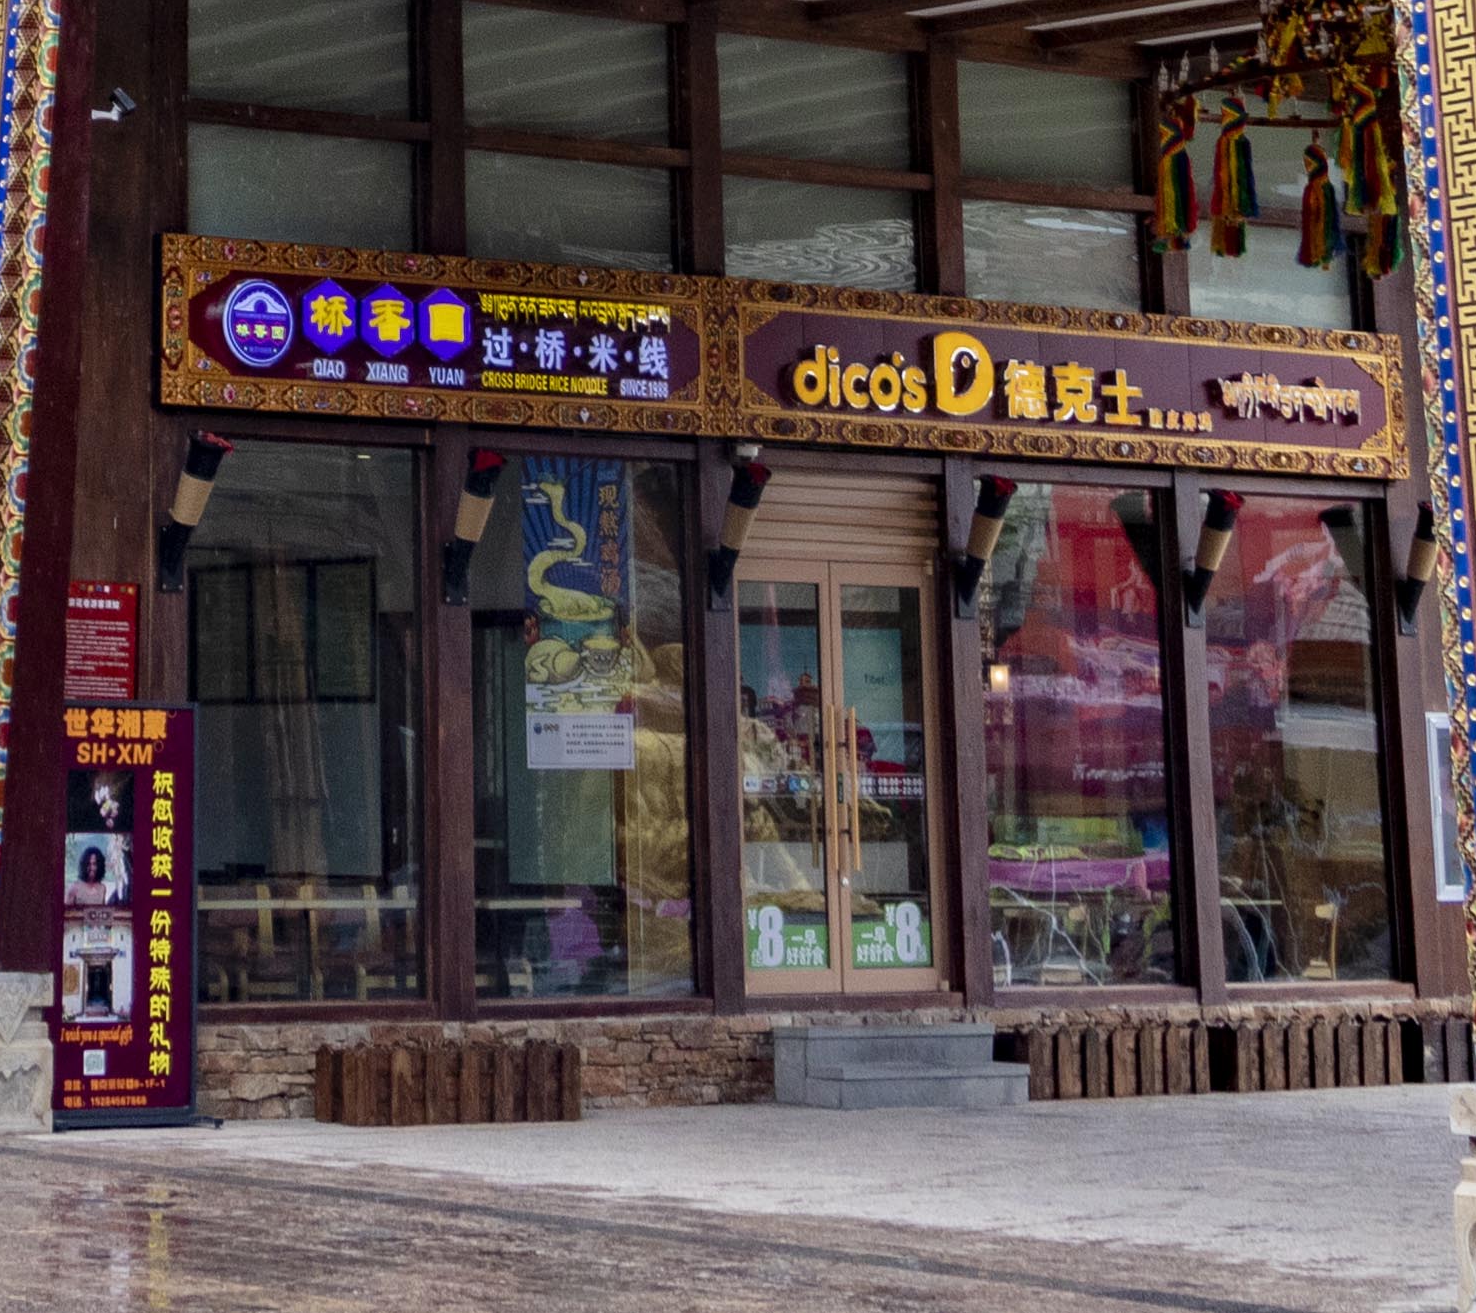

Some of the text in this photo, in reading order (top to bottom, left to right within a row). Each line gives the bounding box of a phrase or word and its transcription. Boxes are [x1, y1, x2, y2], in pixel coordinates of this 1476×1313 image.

[312, 357, 466, 387] QIAO XIANG YUAN
[481, 370, 609, 396] CROSS BRIDGE RICE NOODLE
[619, 378, 647, 397] SINCE
[792, 343, 929, 414] dico's
[1004, 359, 1145, 426] 德克士
[149, 770, 174, 1076] 祝您收获一份特殊的礼物
